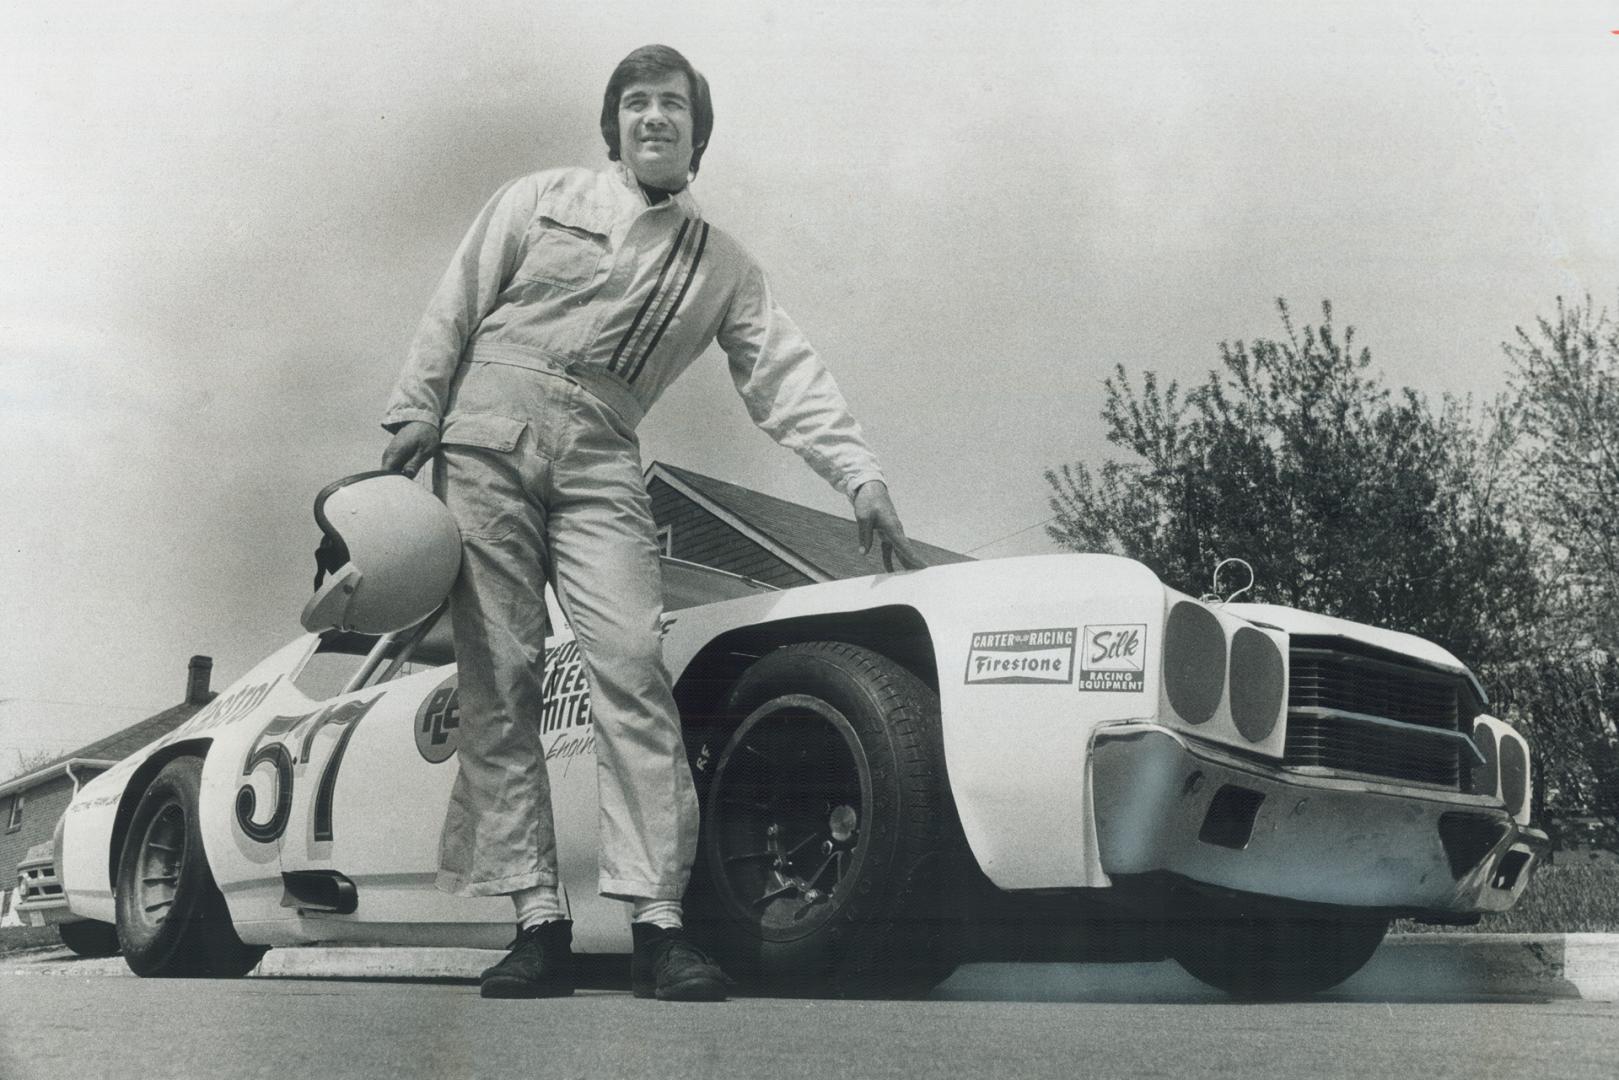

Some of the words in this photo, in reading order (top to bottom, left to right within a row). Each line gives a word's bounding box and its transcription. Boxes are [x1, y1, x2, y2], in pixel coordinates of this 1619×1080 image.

[973, 633, 1014, 648] CARTER
[1029, 631, 1072, 645] RACING
[1091, 629, 1138, 663] Silk
[975, 656, 1062, 674] Firestone
[1080, 680, 1143, 690] EQUIPMENT
[1090, 672, 1132, 681] RACING
[235, 690, 388, 845] 57
